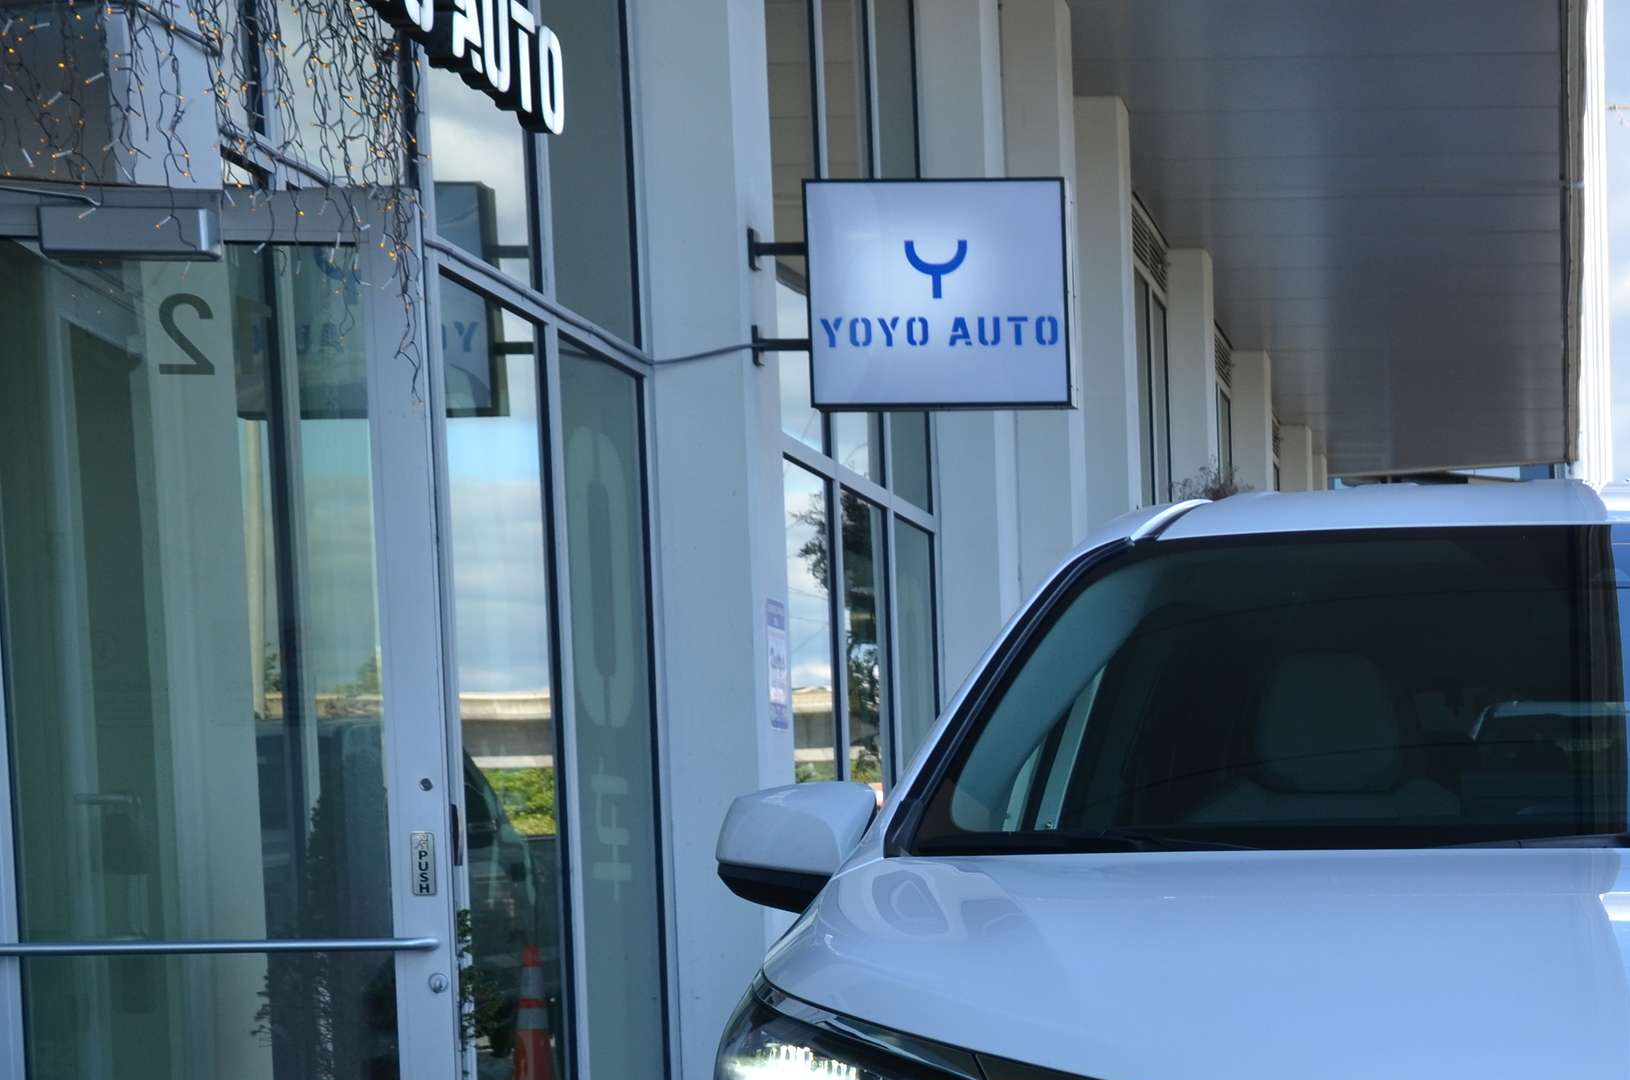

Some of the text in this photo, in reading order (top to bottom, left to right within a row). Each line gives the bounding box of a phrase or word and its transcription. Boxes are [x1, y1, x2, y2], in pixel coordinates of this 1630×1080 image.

[452, 0, 565, 136] AUTO
[820, 316, 1059, 348] YOYO AUTO
[418, 850, 430, 893] PUSH
